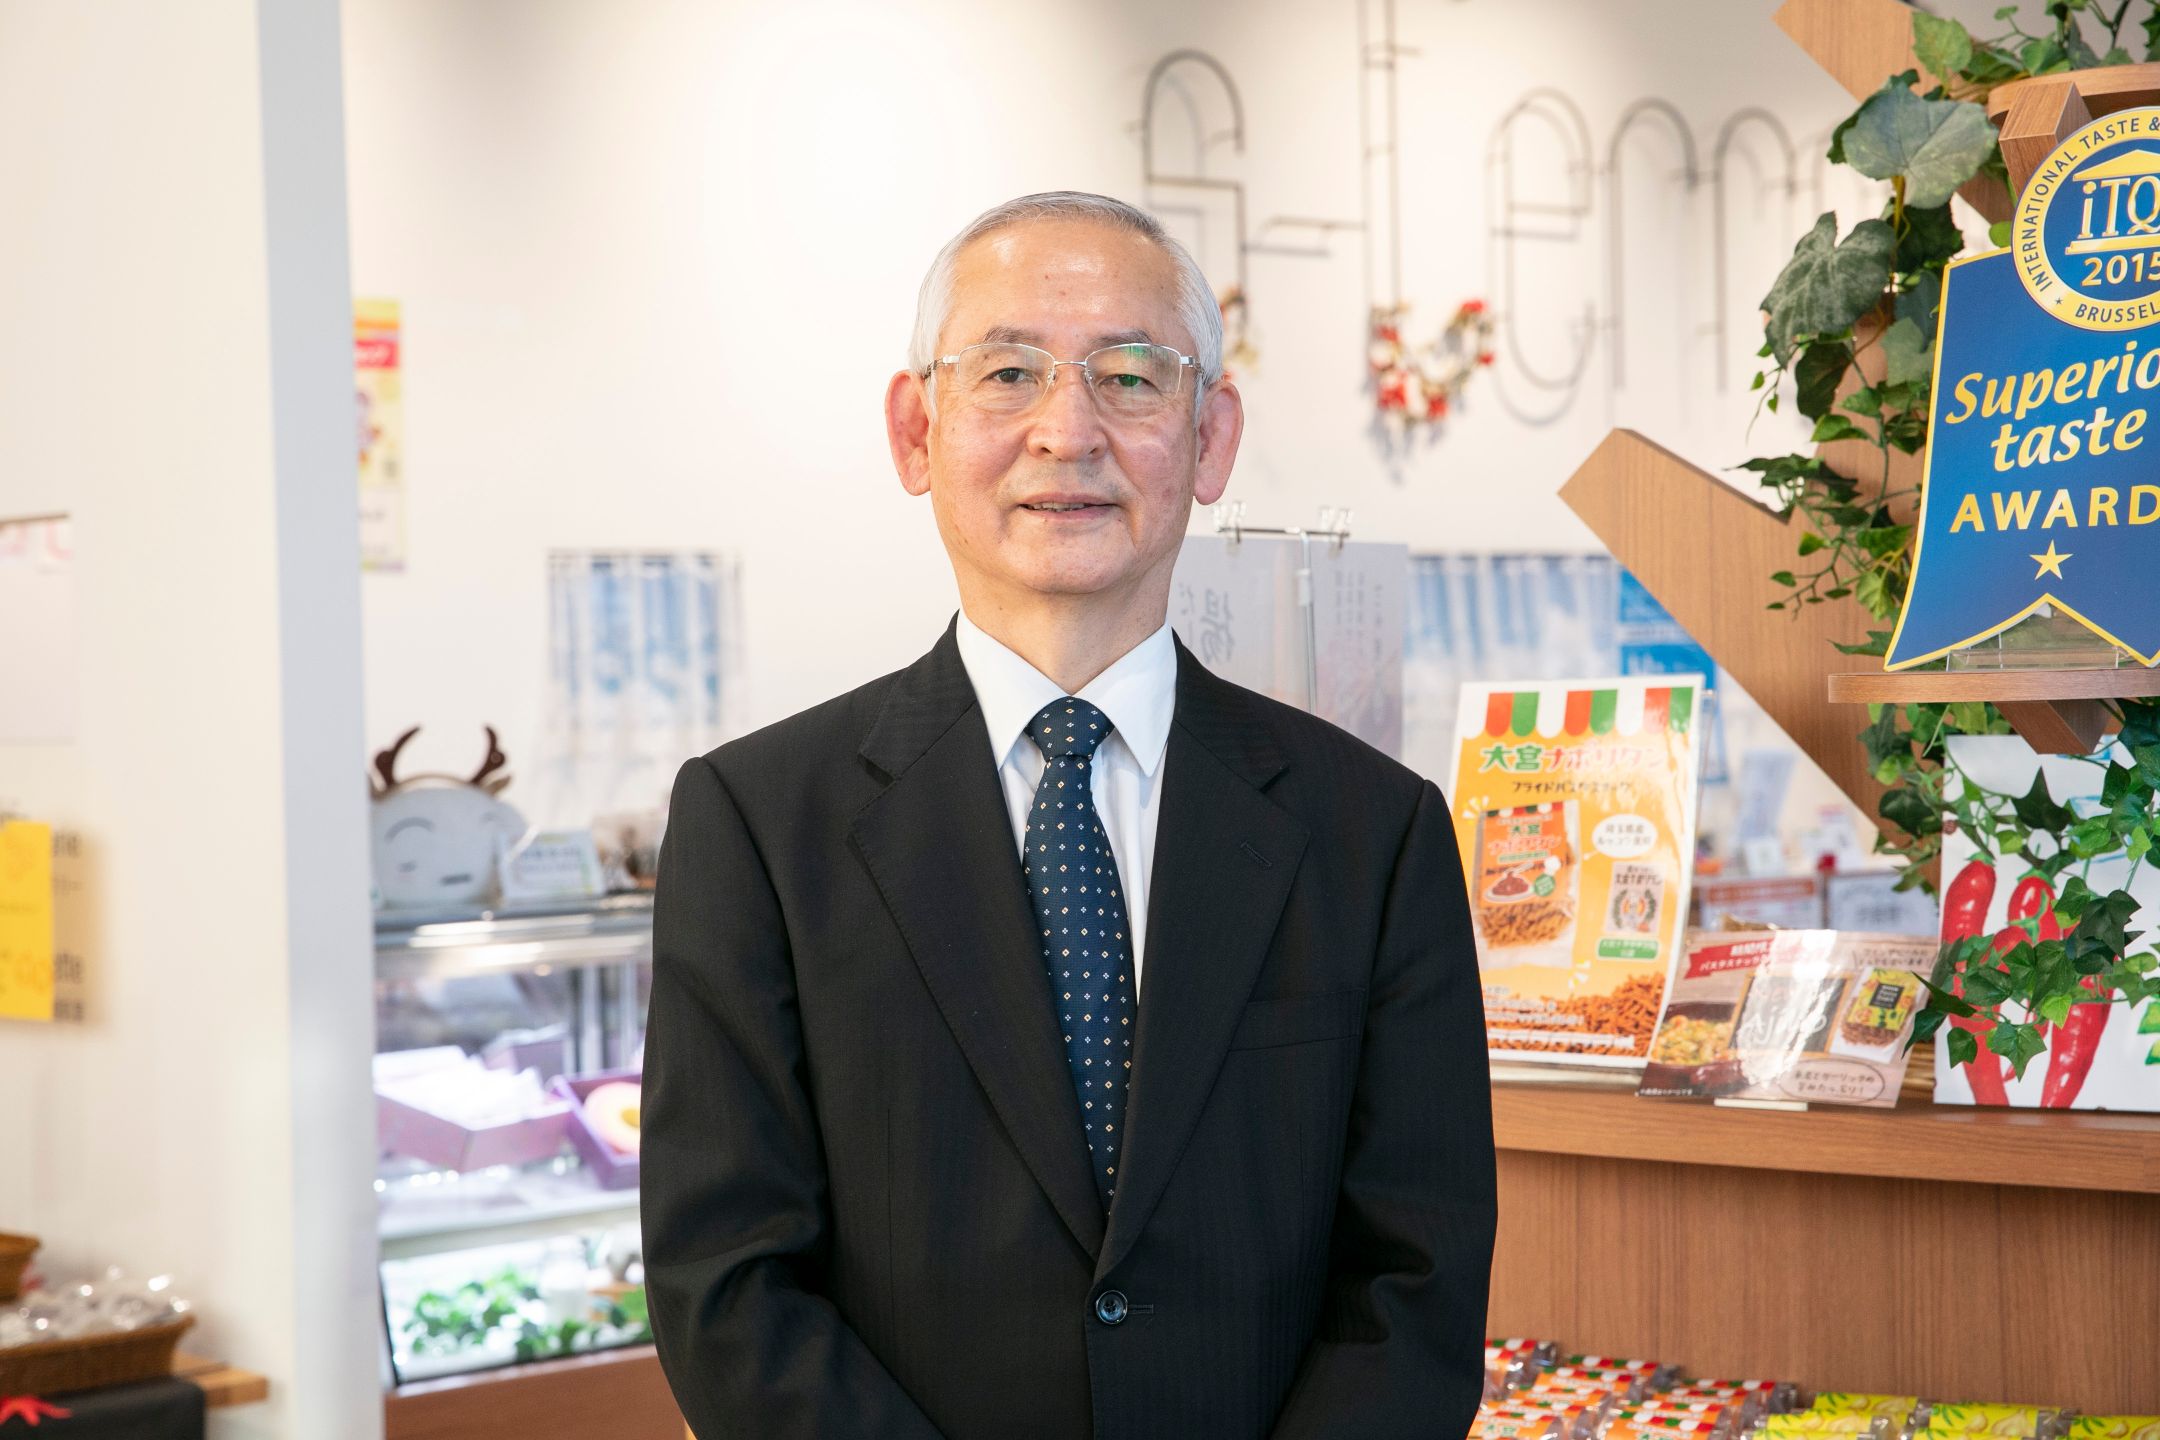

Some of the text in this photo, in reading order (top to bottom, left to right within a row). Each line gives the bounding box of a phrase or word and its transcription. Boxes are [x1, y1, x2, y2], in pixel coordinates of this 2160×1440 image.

[2021, 116, 2160, 292] INTERNATIONAL TASTE &
[2081, 252, 2160, 287] 2015
[1945, 340, 2160, 424] Superio
[1991, 406, 2148, 472] taste
[1949, 484, 2160, 533] AWARD
